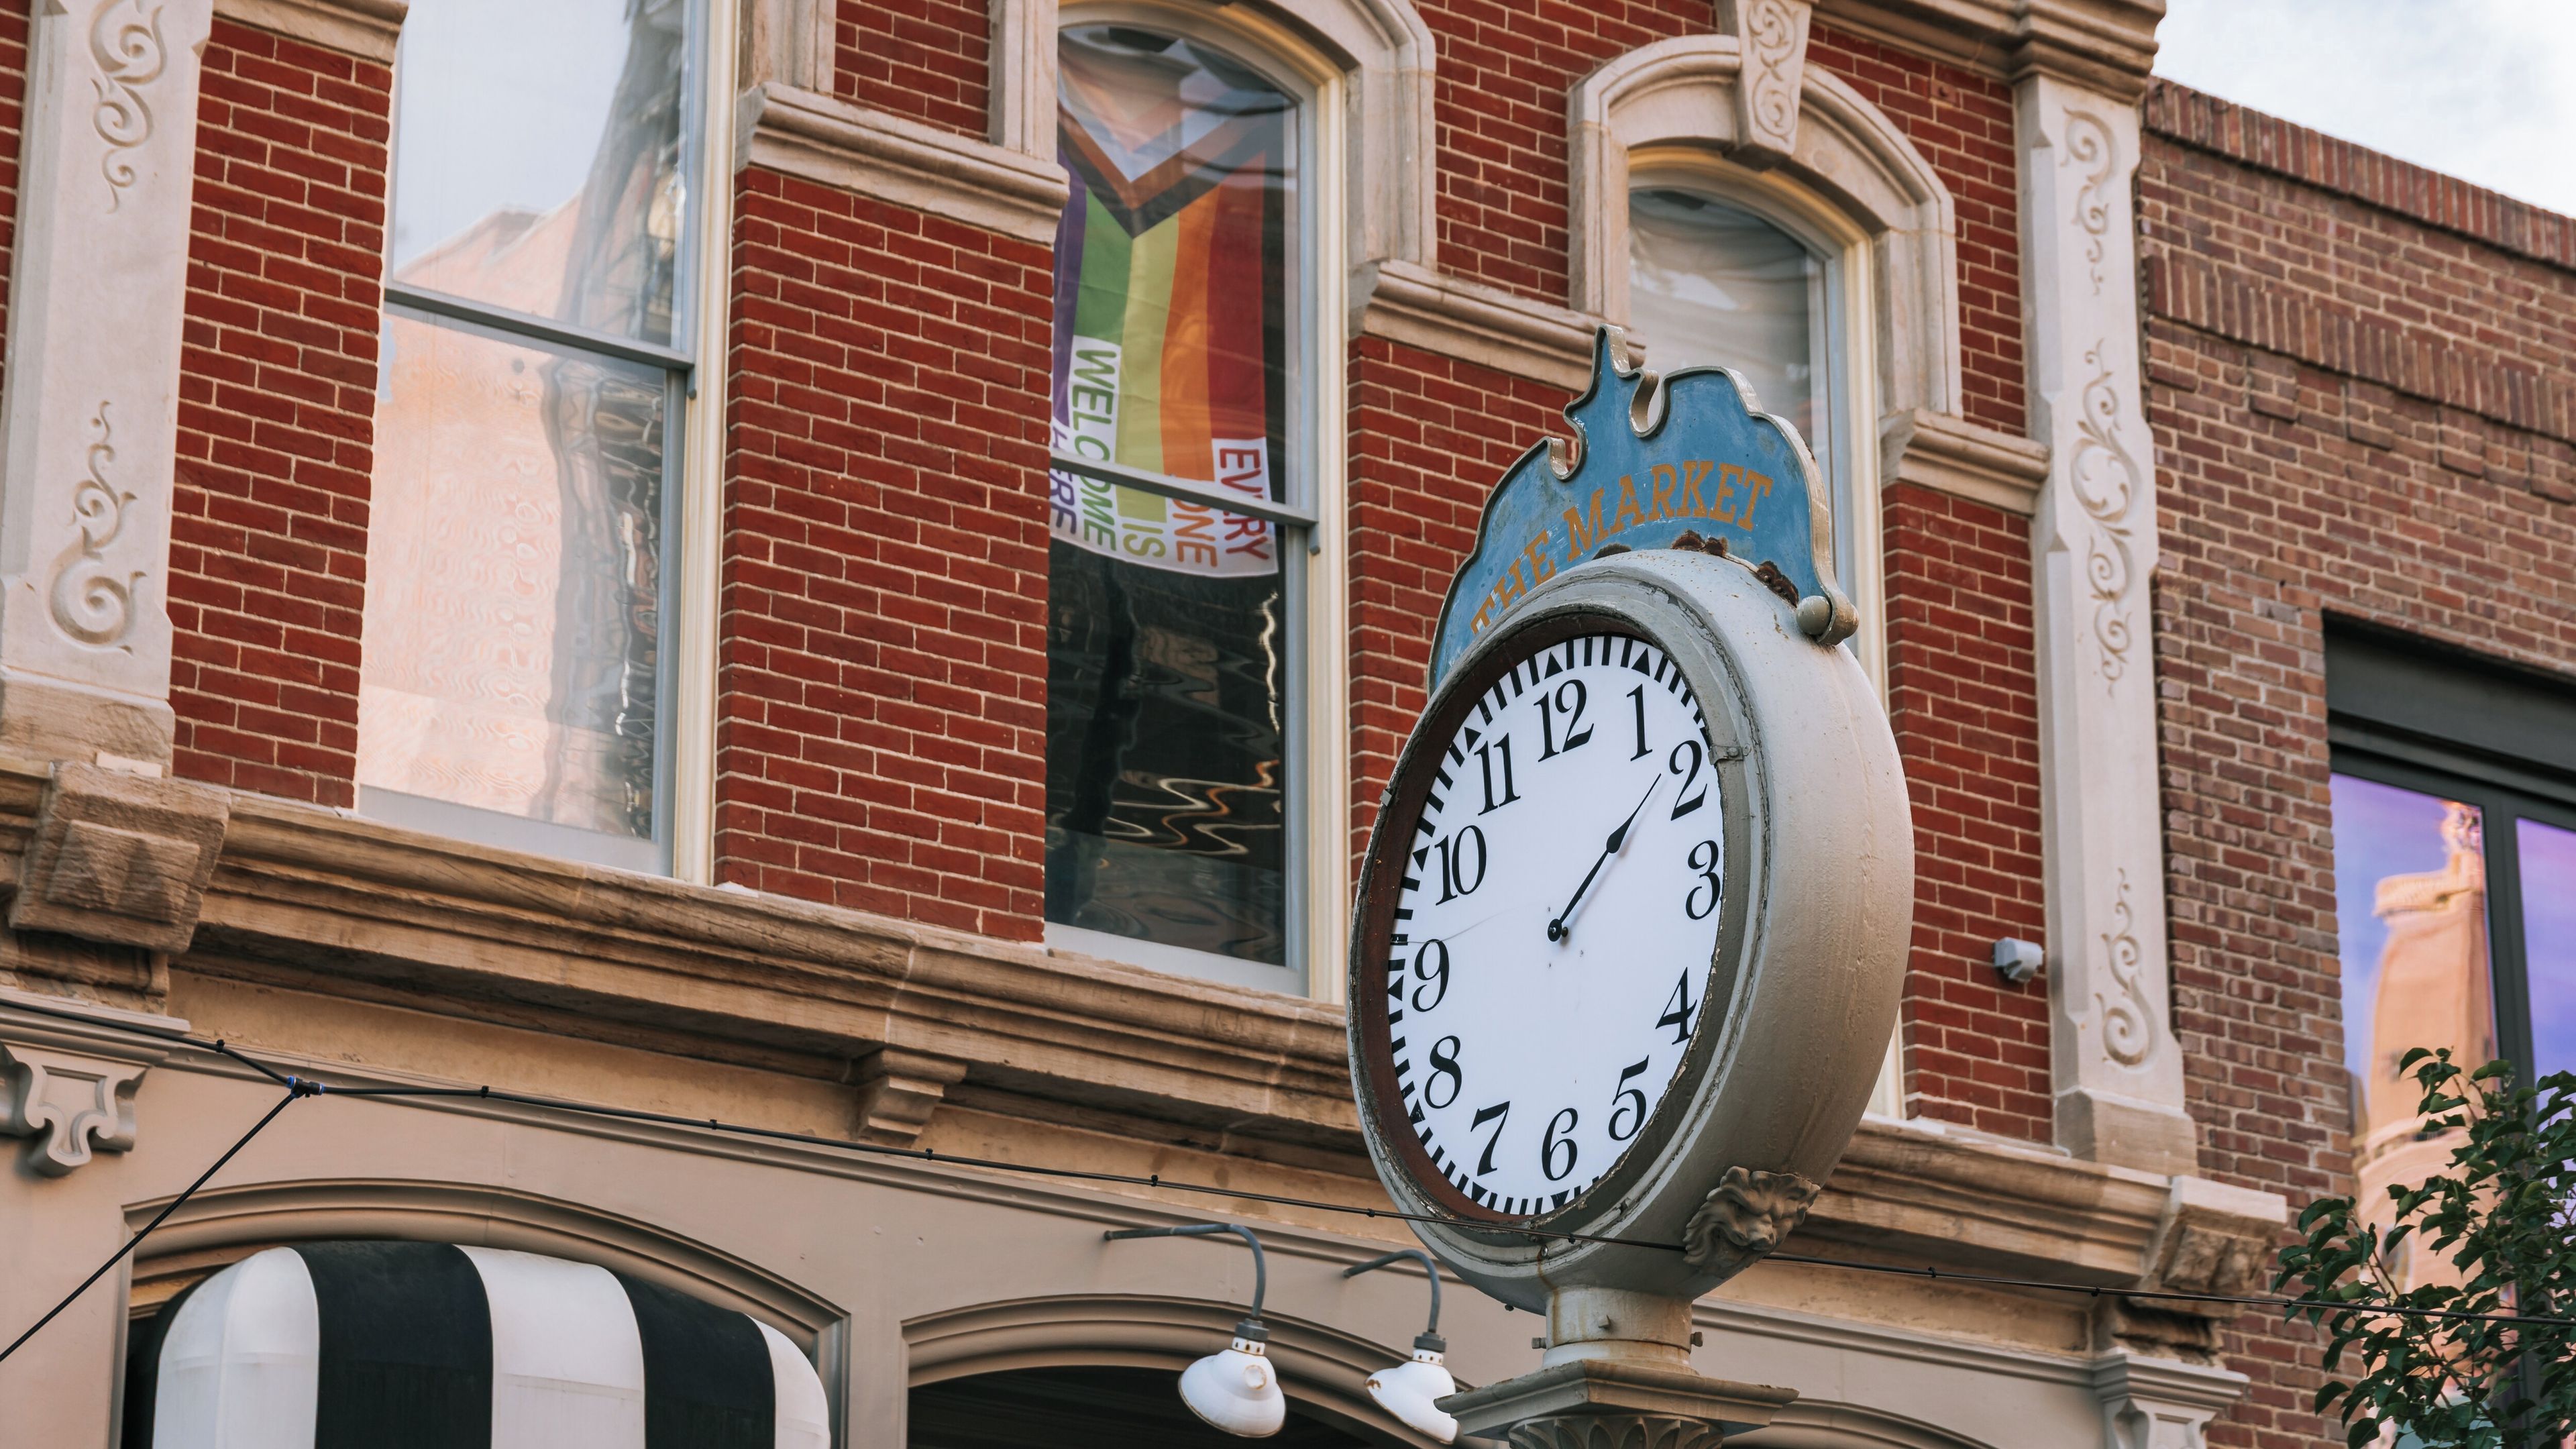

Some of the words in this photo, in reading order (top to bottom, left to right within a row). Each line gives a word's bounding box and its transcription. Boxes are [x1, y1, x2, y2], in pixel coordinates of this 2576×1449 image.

[1122, 523, 1167, 557] IS
[1220, 448, 1270, 560] EVRY
[1470, 529, 1556, 636] THE
[1563, 460, 1774, 561] MARKET
[1534, 679, 1594, 762] 12
[1626, 684, 1653, 761] 1
[1474, 732, 1521, 816] 11
[1668, 740, 1707, 821] 2
[1434, 824, 1487, 906] 10
[1685, 840, 1721, 920] 3
[1411, 939, 1450, 1012] 9
[1655, 967, 1698, 1045] 4
[1424, 1035, 1462, 1109] 8
[1608, 1055, 1650, 1141] 5
[1470, 1101, 1511, 1177] 7
[1542, 1108, 1578, 1181] 6
